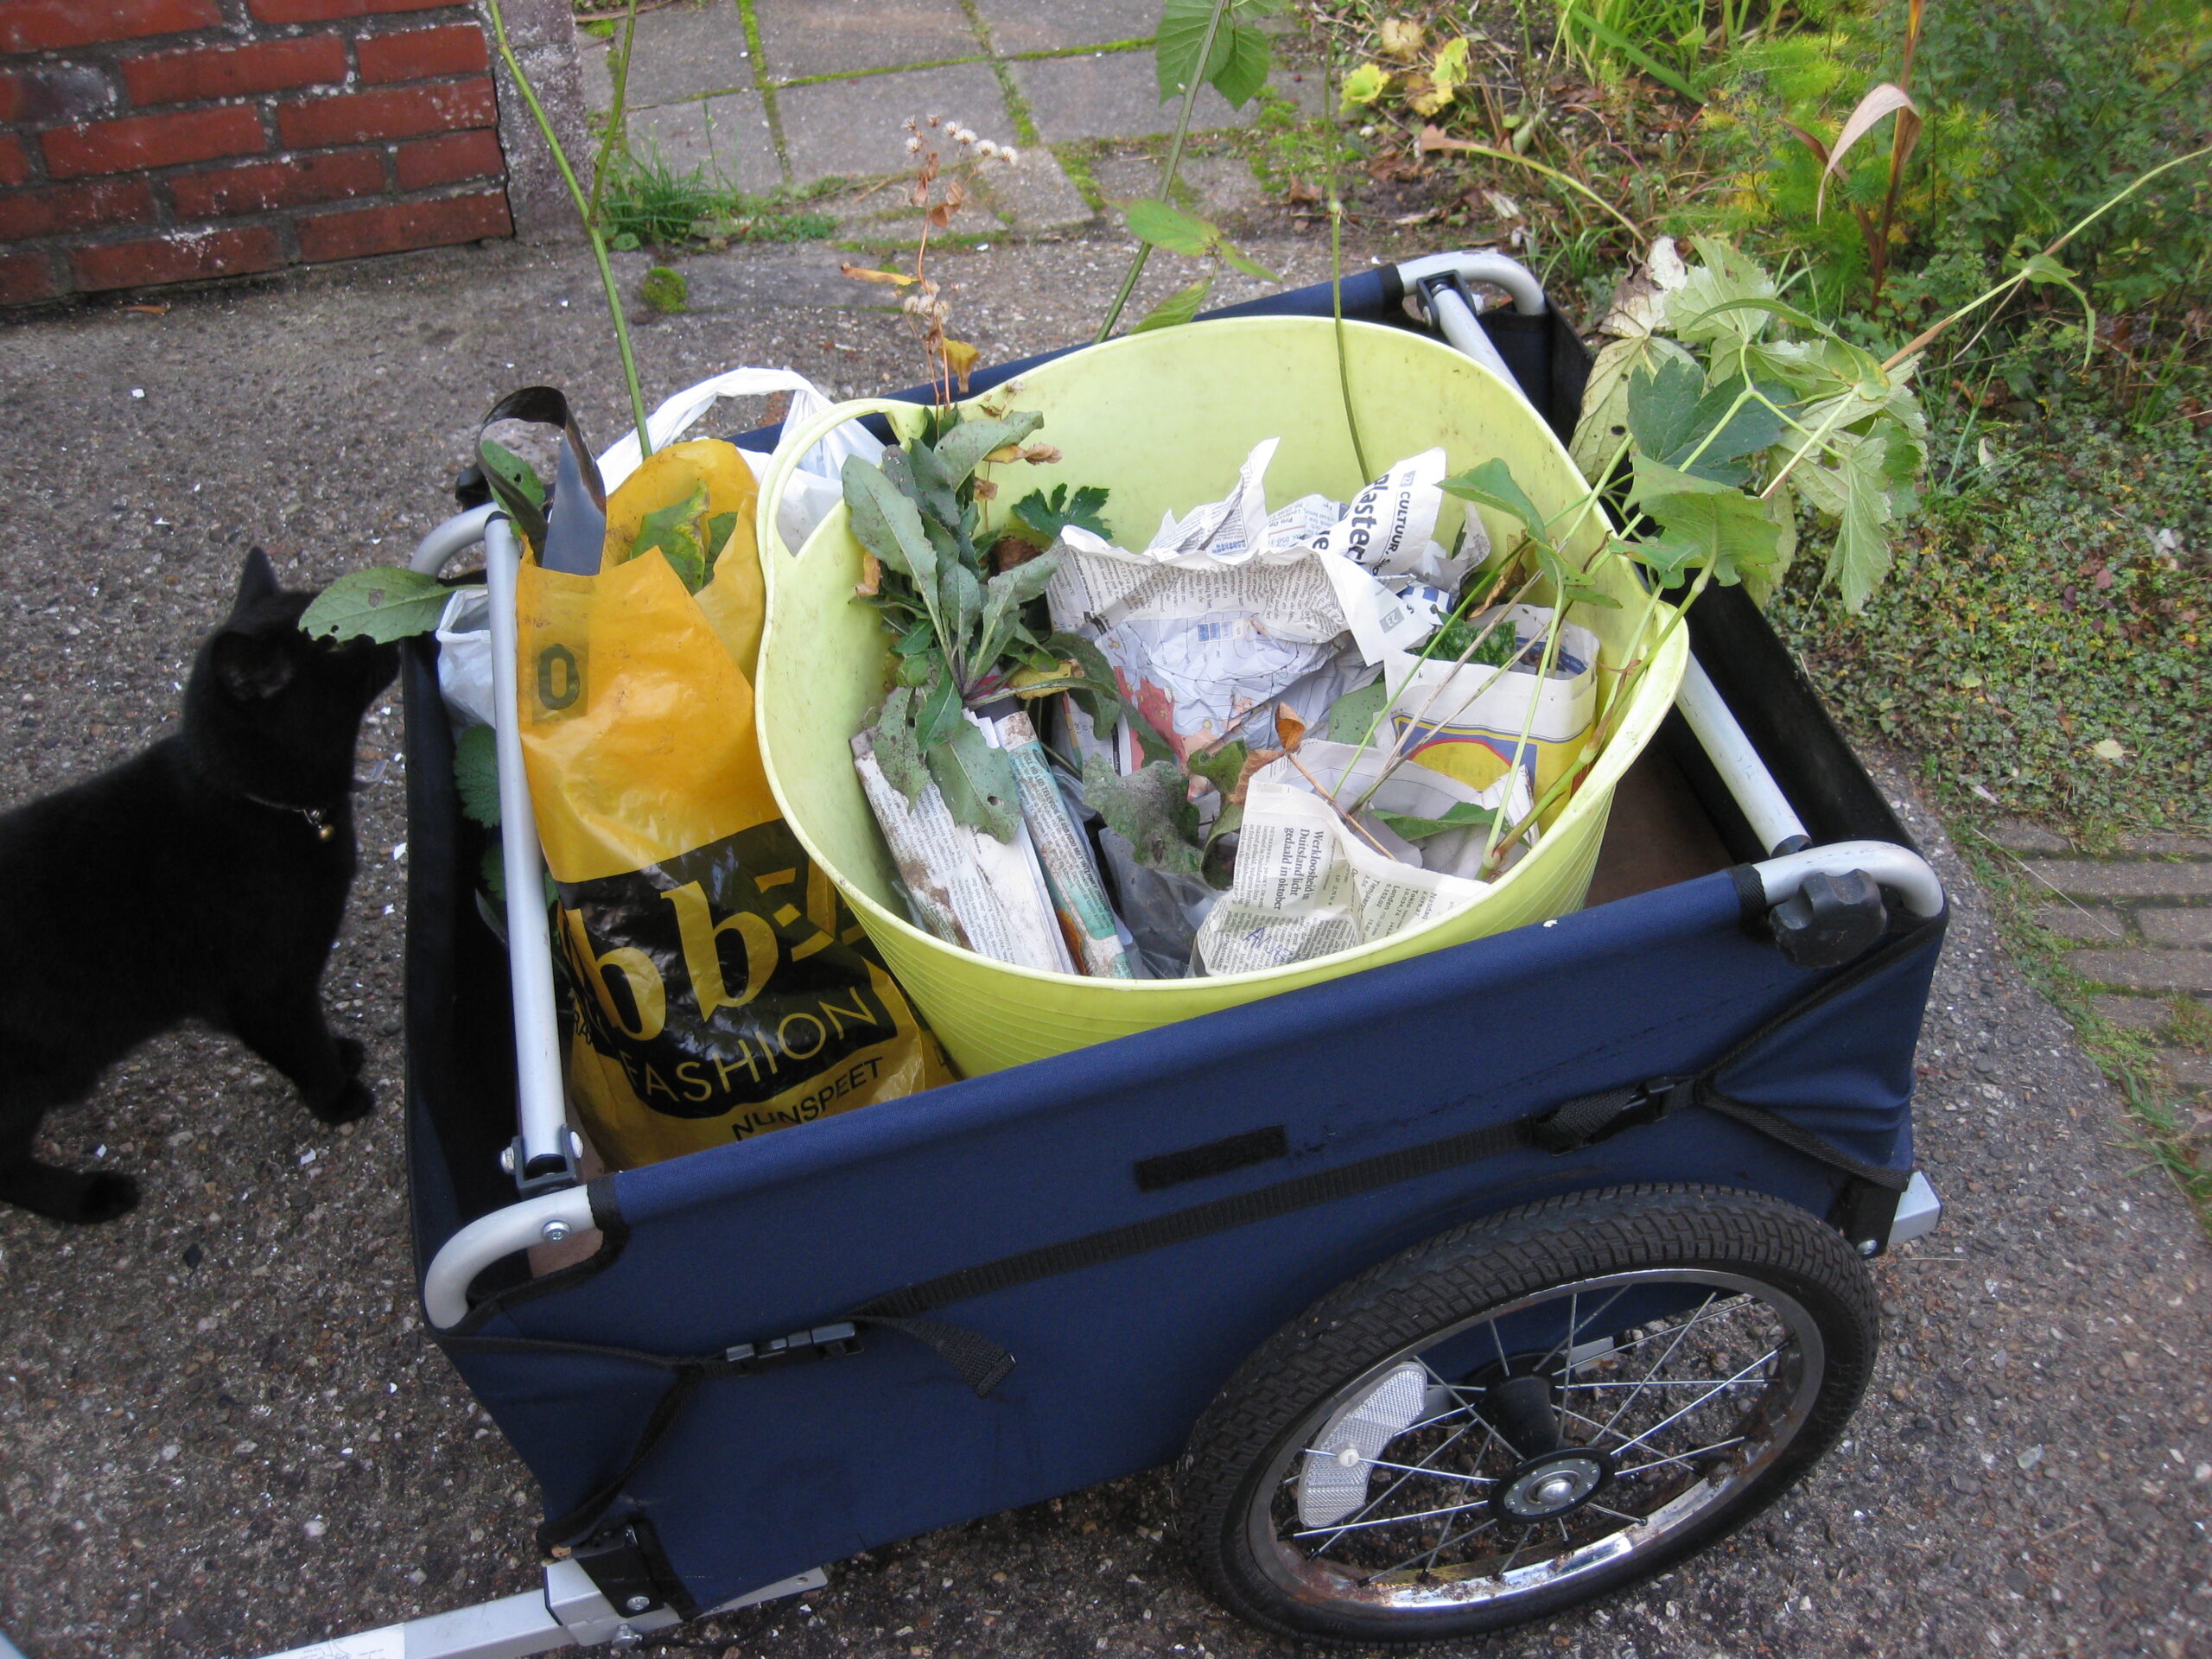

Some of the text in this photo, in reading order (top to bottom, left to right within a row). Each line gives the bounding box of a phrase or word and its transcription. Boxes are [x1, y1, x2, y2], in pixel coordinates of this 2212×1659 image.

[1386, 491, 1412, 555] CULTUUR,
[1384, 613, 1400, 627] 23
[1273, 827, 1295, 911] gedaald in oktober
[1289, 829, 1309, 896] Duitsland licht
[1301, 830, 1323, 901] Werkloosheid in
[1383, 885, 1400, 911] Londen
[1405, 888, 1418, 908] Tokio
[1421, 892, 1437, 920] Nasdaq
[619, 986, 877, 1102] FASHION
[731, 1056, 883, 1141] NUNSPEET
